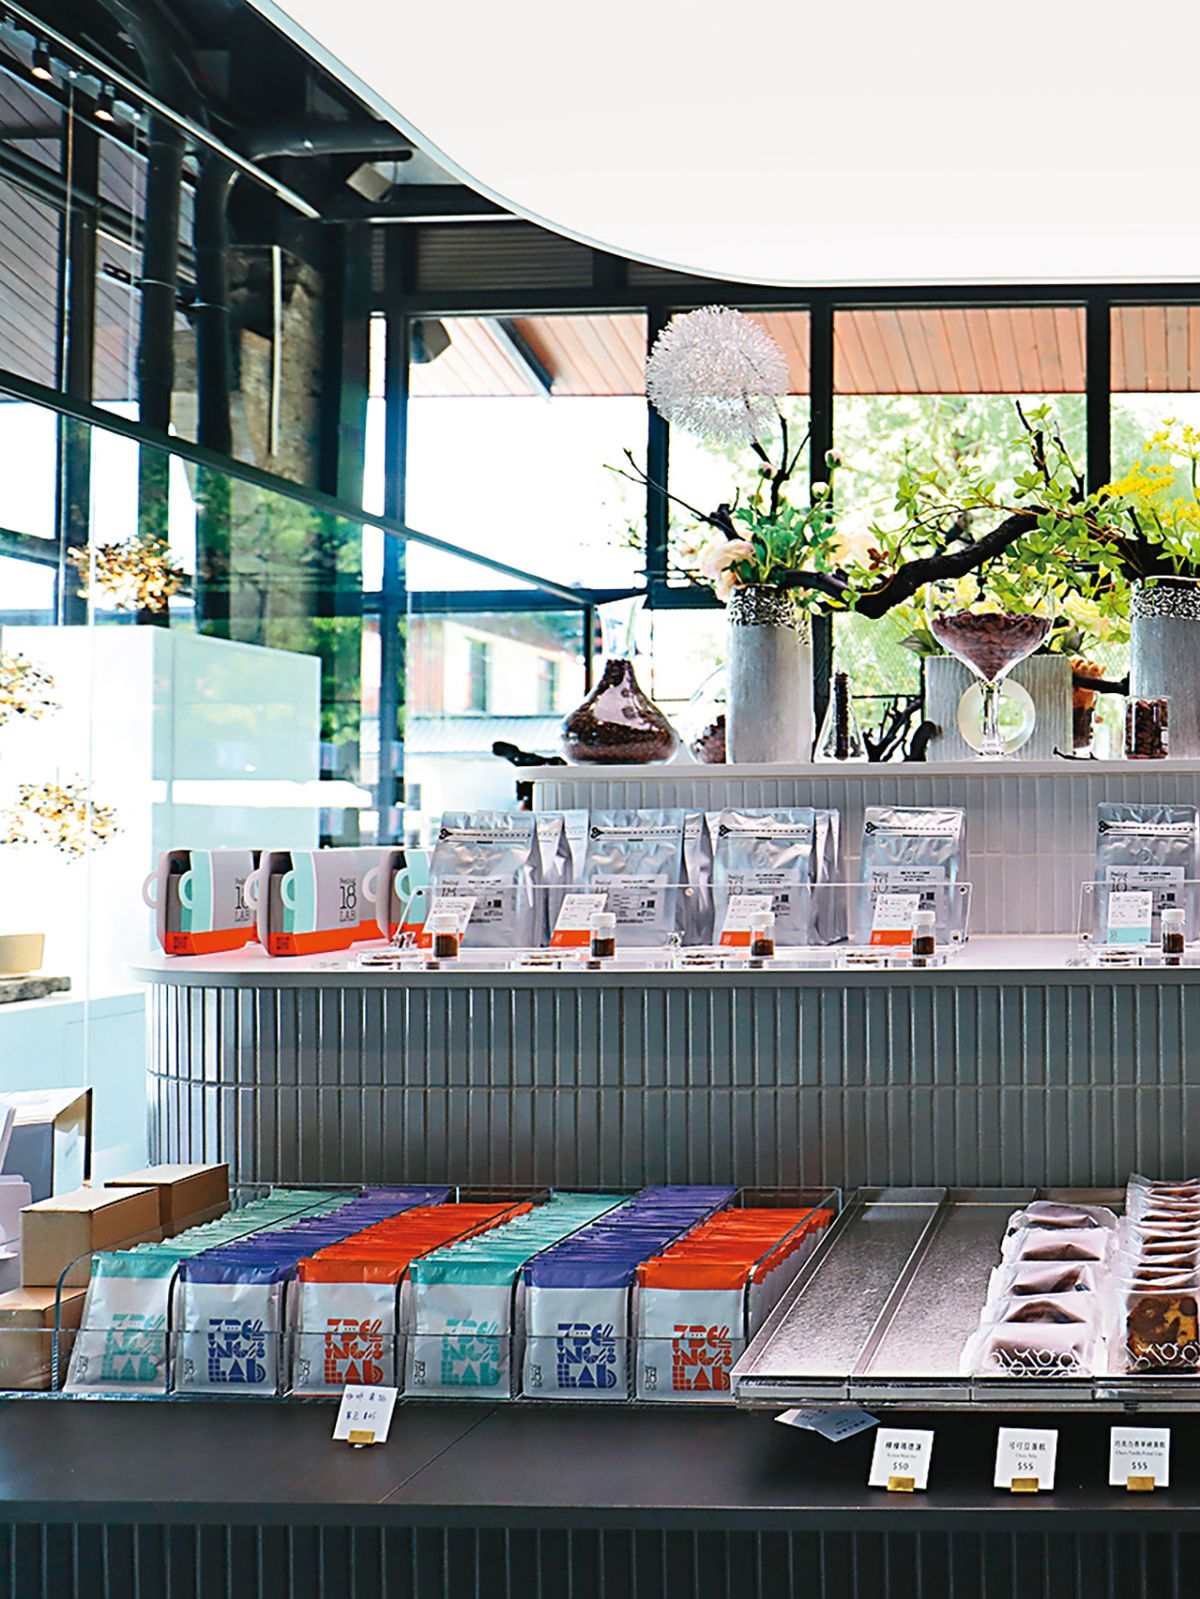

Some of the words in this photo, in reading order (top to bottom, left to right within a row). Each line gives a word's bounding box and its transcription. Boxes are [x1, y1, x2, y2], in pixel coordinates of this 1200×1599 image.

[340, 885, 357, 909] 18
[339, 910, 356, 922] LAB
[893, 1462, 909, 1470] $50
[1018, 1462, 1034, 1470] $55
[1132, 1461, 1148, 1470] $55
